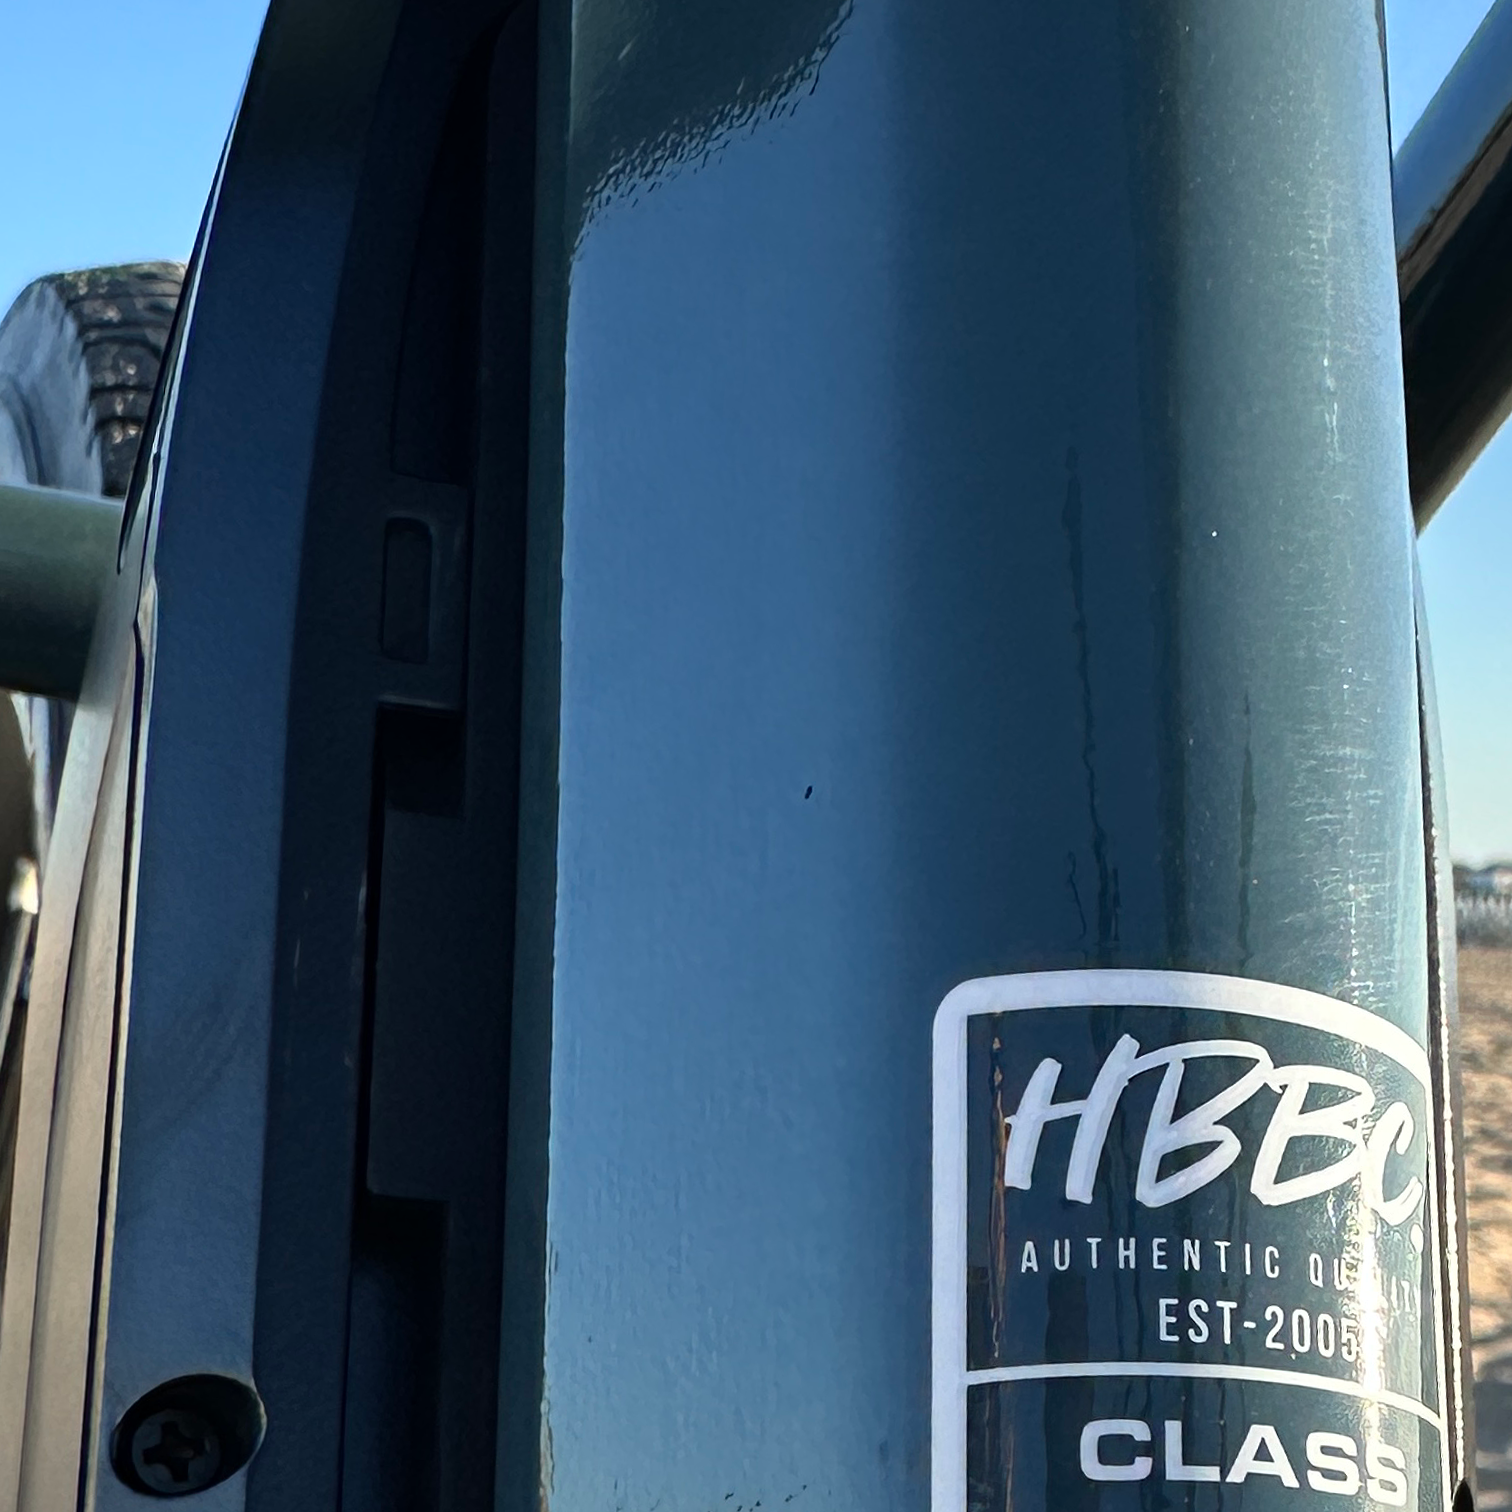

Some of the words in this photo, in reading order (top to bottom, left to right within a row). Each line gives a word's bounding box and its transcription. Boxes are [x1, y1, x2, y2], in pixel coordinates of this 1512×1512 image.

[1021, 1237, 1281, 1279] AUTHENTIC
[1159, 1297, 1358, 1363] EST-2005
[1080, 1419, 1408, 1507] CLASS
